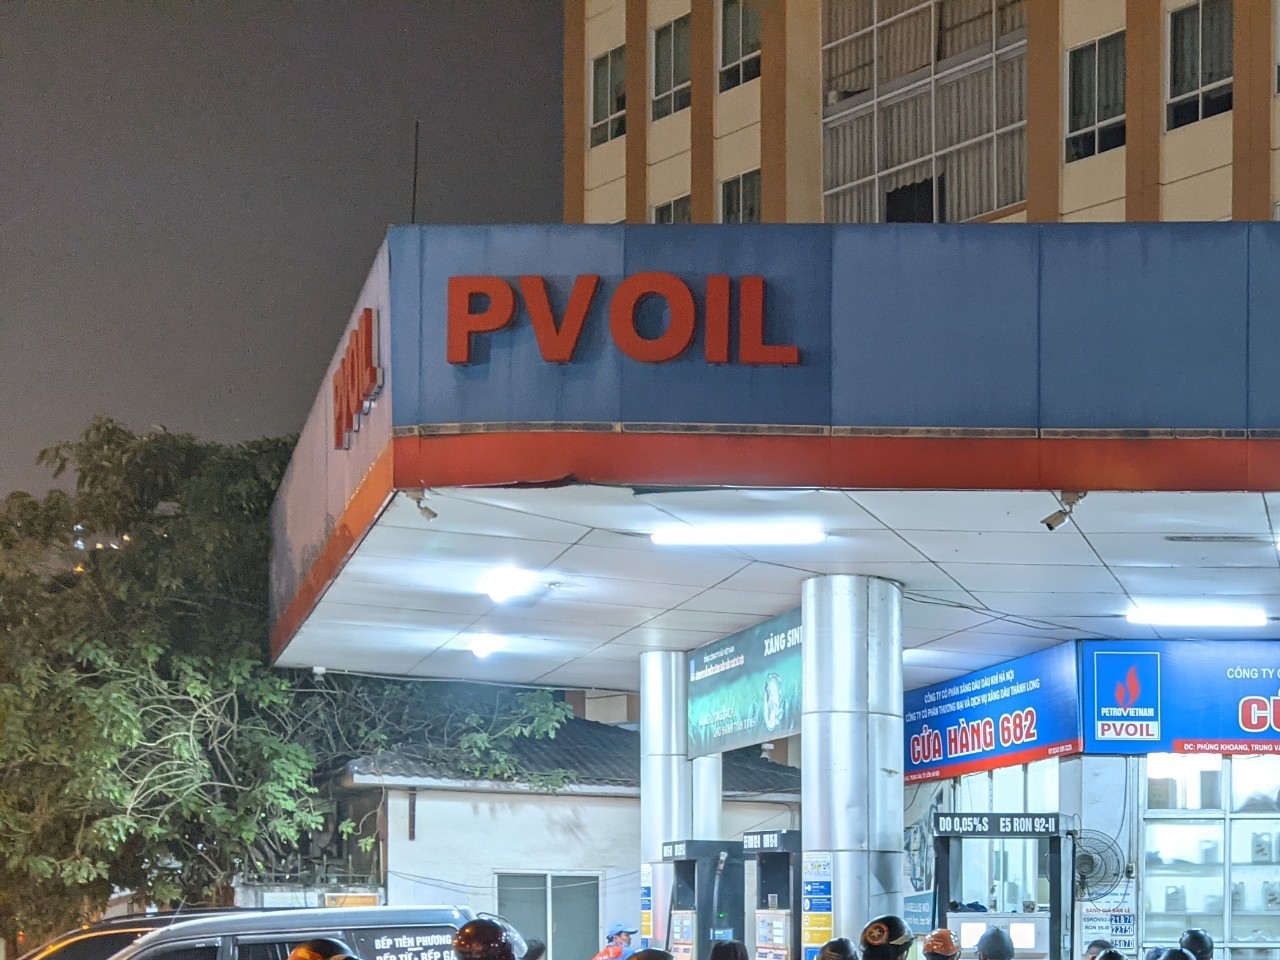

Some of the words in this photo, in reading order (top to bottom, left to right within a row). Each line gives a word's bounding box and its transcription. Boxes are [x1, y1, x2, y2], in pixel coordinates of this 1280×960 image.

[447, 271, 800, 365] PVOIL
[1226, 666, 1258, 679] CÔNG
[1261, 667, 1275, 679] TY
[1101, 707, 1154, 717] PETROVIETNAM
[910, 723, 943, 765] CỬA
[947, 717, 995, 759] HÀNG
[999, 706, 1038, 748] 682
[1100, 722, 1155, 737] PVOIL
[939, 817, 951, 832] DO
[1000, 817, 1011, 832] E5
[1013, 818, 1032, 832] RON
[375, 936, 393, 950] BẾP
